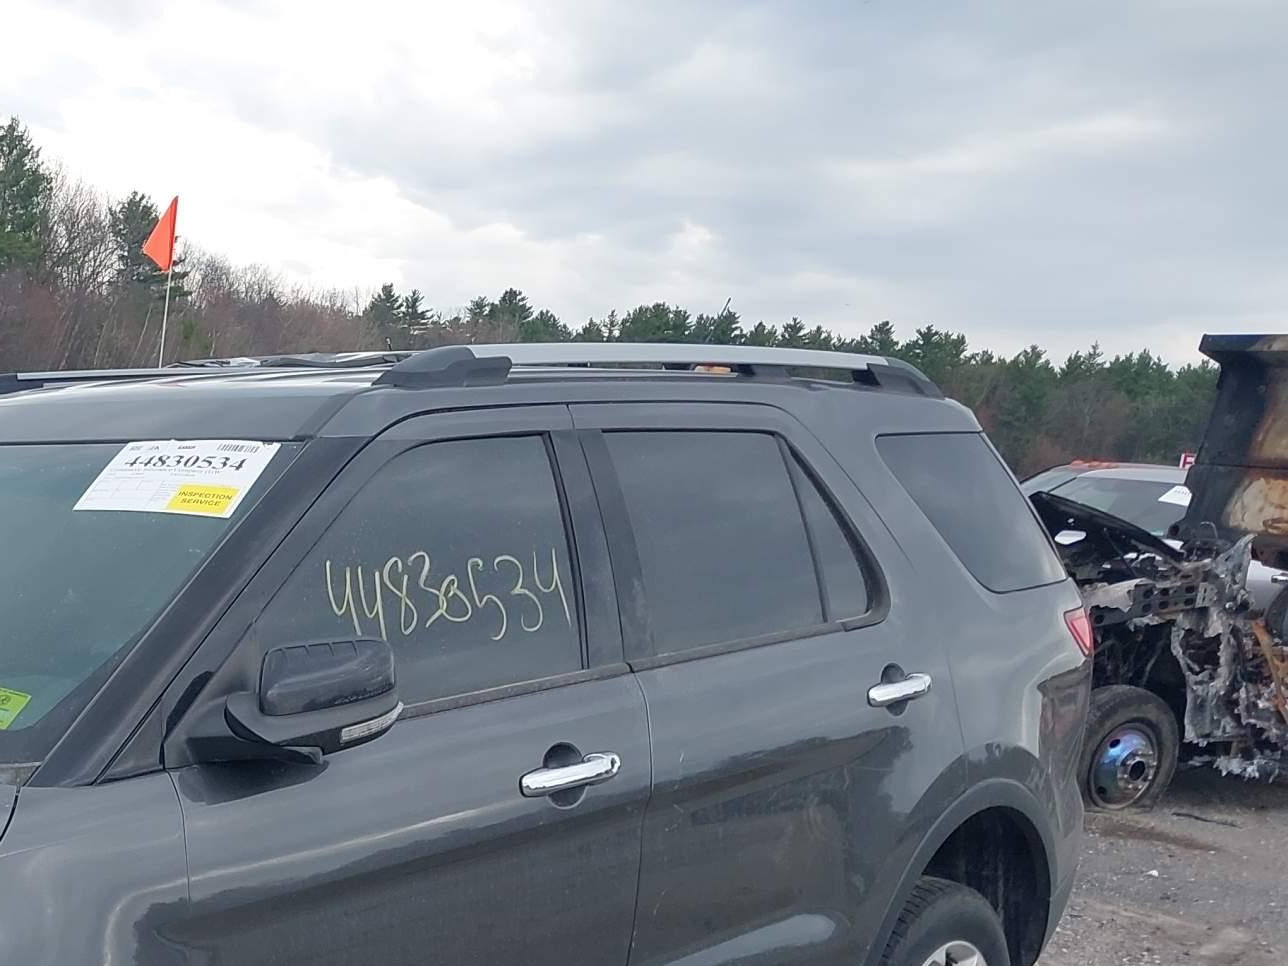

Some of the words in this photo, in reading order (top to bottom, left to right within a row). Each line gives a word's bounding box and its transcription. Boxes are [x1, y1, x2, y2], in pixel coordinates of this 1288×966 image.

[124, 454, 249, 471] 44830534
[177, 490, 233, 500] INSPECTION
[179, 497, 222, 506] SERVICE
[325, 547, 572, 641] 44830534
